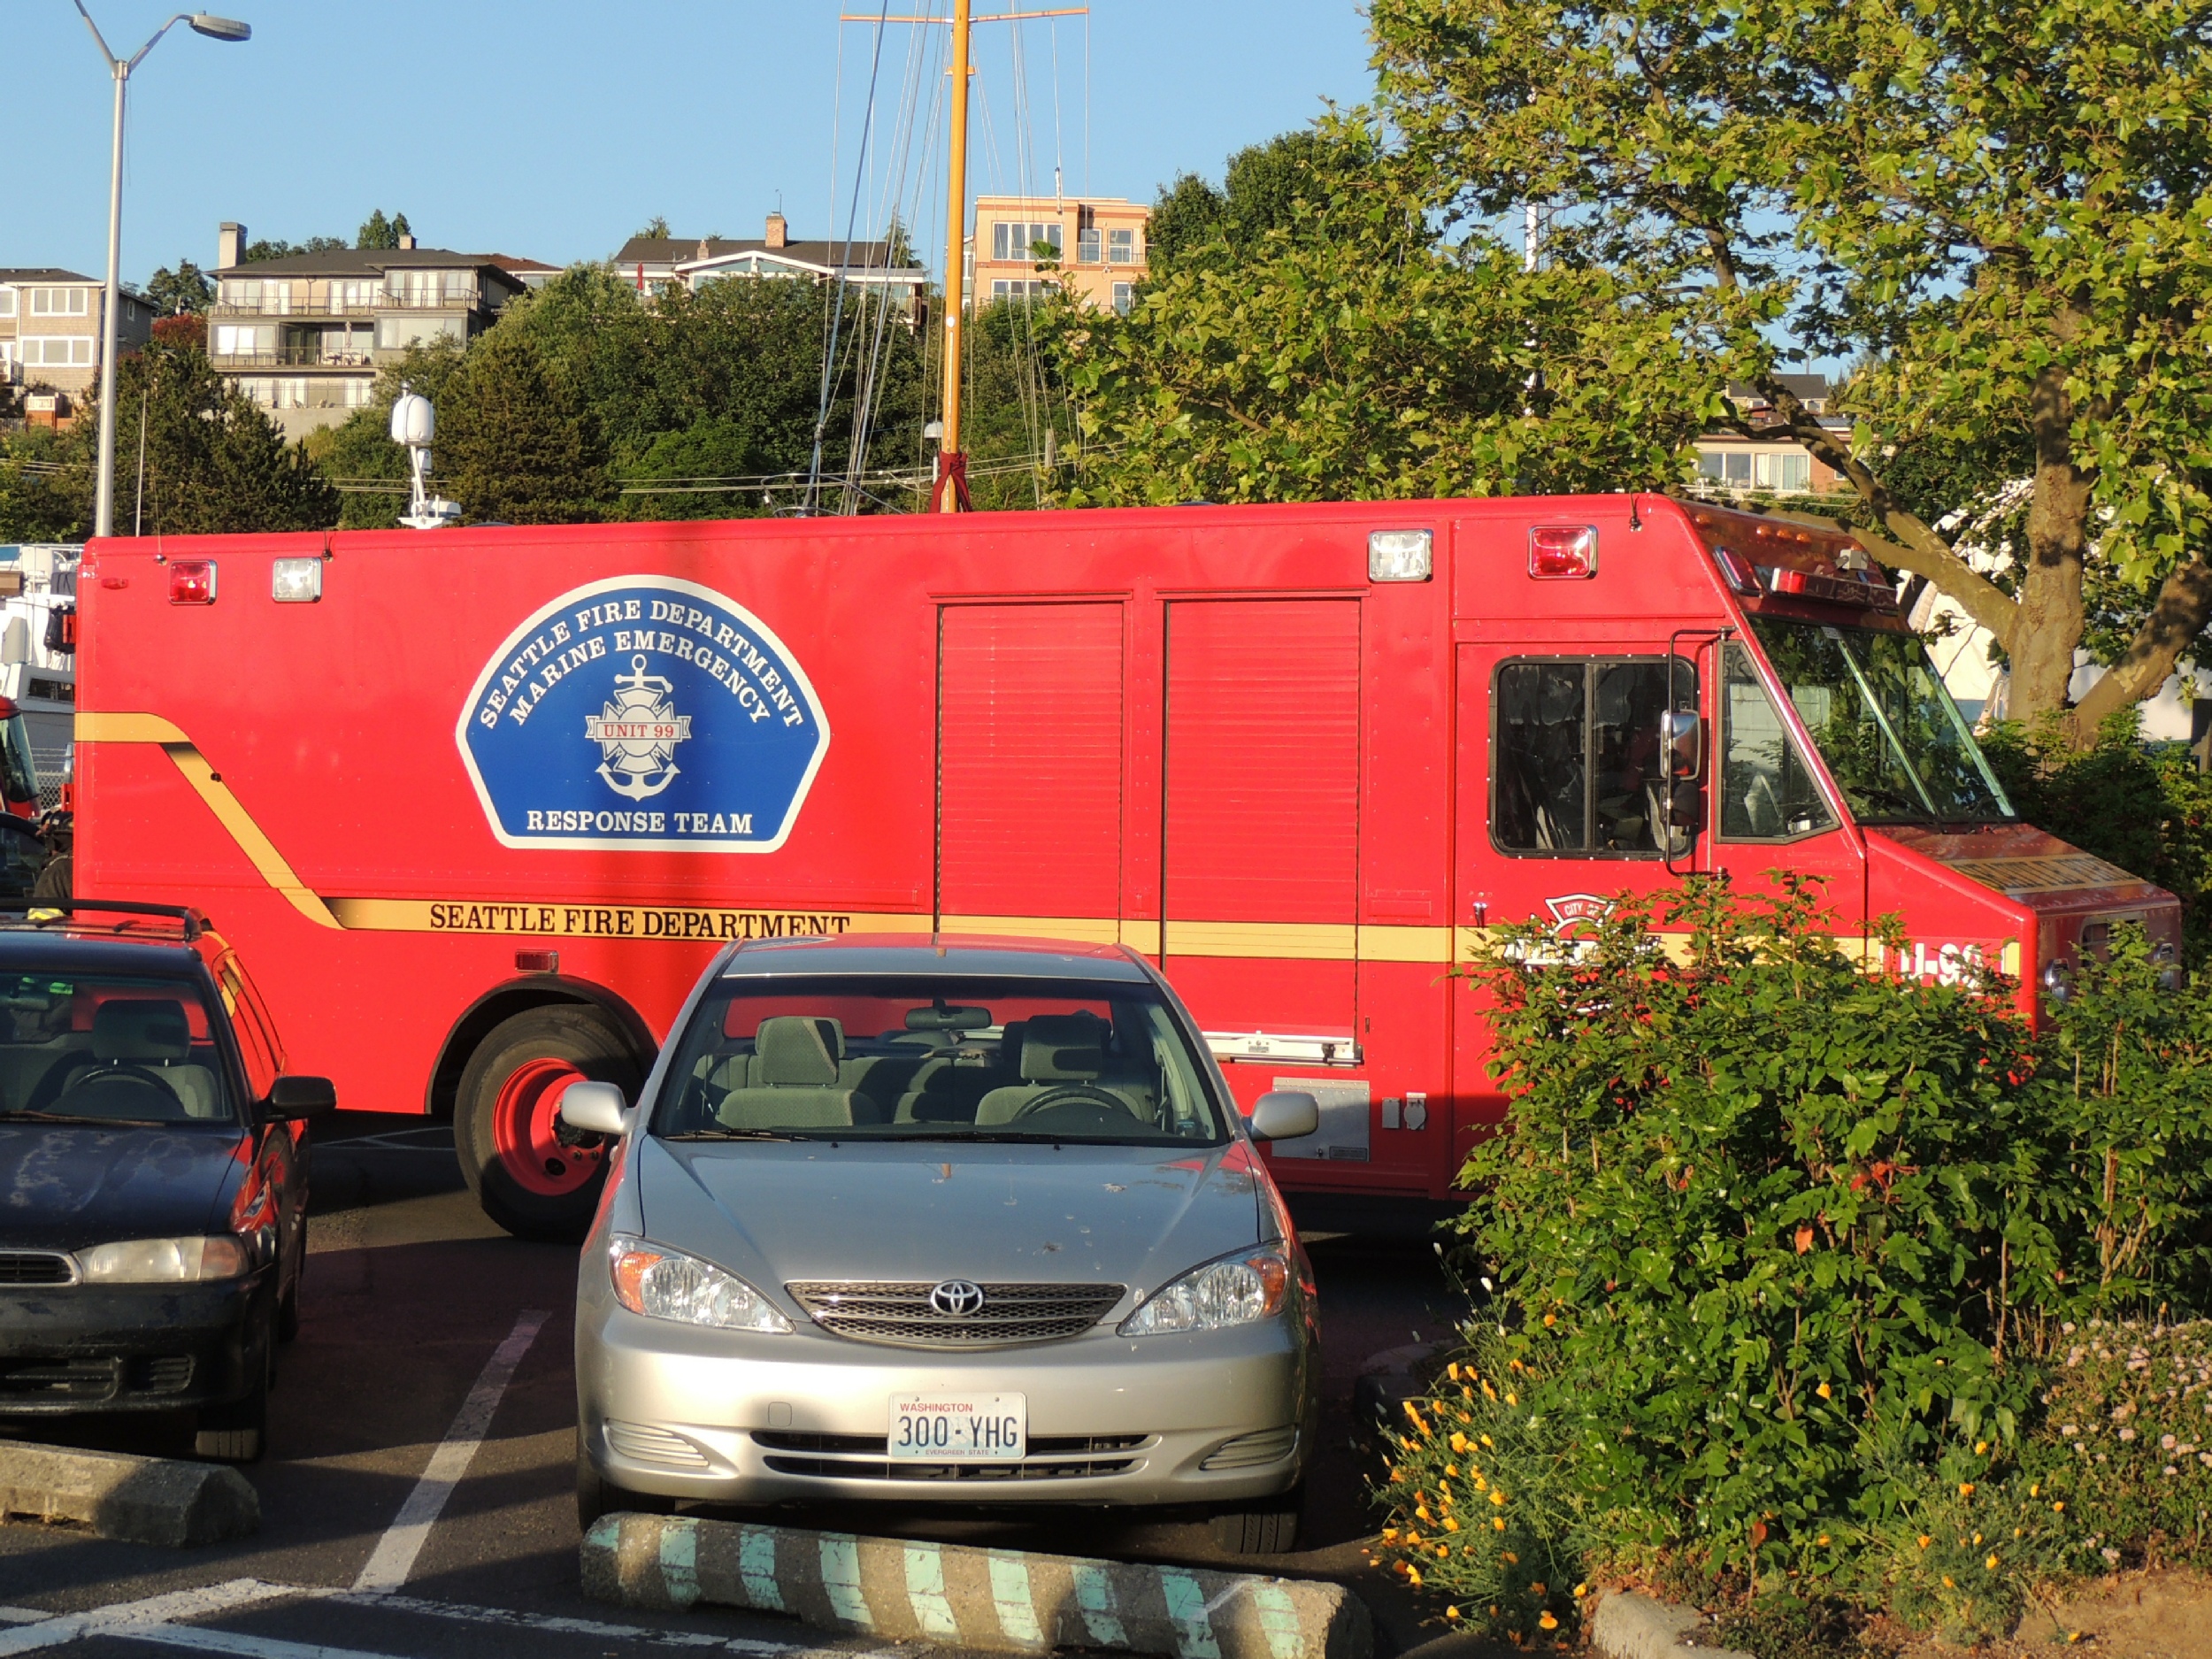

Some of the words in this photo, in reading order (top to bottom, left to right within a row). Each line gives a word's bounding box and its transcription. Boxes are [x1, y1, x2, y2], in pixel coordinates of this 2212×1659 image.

[480, 620, 572, 729] SEATTLE
[575, 600, 641, 634] FIRE
[649, 600, 804, 729] DEPARTMENT
[509, 636, 607, 726] MARINE
[614, 630, 771, 725] EMERGENCY
[603, 725, 648, 738] UNIT
[654, 726, 674, 738] 99
[527, 810, 665, 833] RESPONSE
[674, 813, 753, 834] TEAM
[430, 903, 556, 933] SEATTLE
[563, 909, 634, 935] FIRE
[642, 910, 850, 939] DEPARTMENT
[1564, 902, 1584, 916] CITY
[900, 1402, 973, 1413] WASHINGTON
